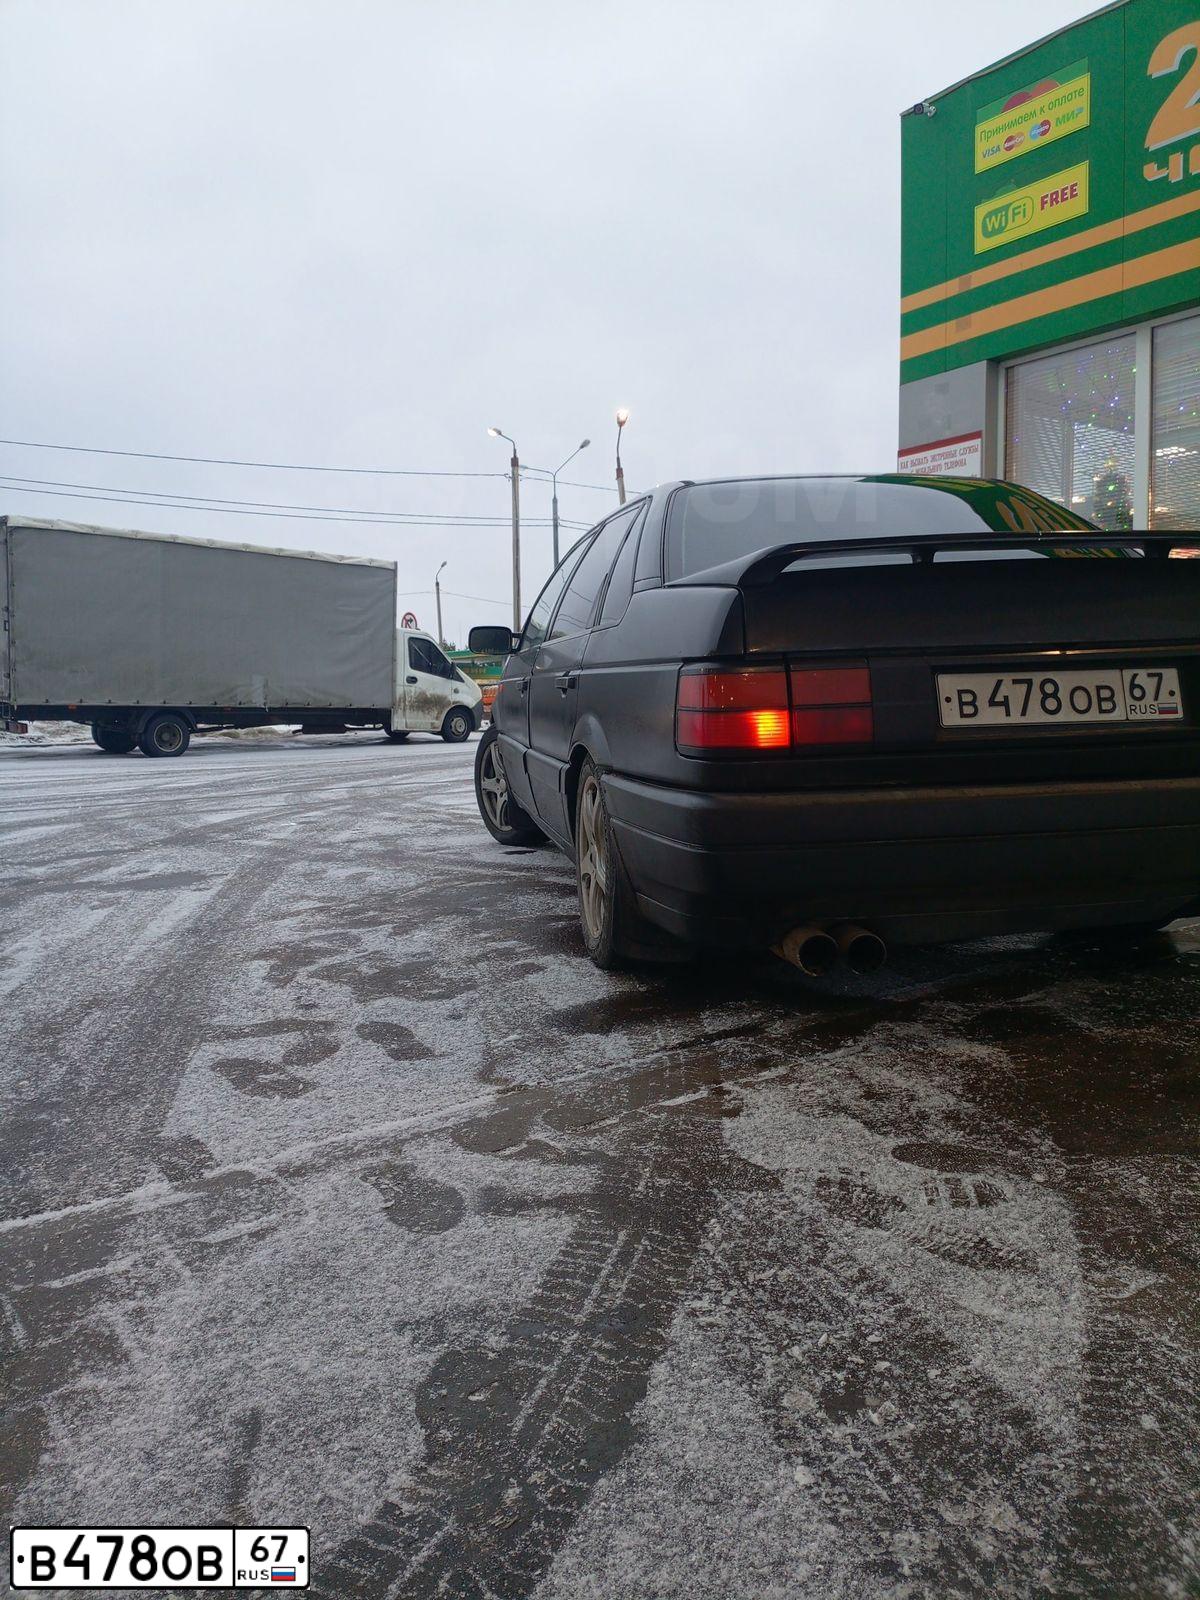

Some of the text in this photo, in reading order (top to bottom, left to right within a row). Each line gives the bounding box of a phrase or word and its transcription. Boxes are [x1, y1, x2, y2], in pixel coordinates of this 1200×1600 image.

[979, 110, 1038, 142] Принимаем
[1040, 105, 1046, 115] к
[1047, 88, 1085, 111] оплате
[982, 144, 1001, 159] VISA
[1040, 182, 1079, 212] FREE
[956, 672, 1164, 719] В478ОВ 67
[1129, 703, 1158, 715] RUS
